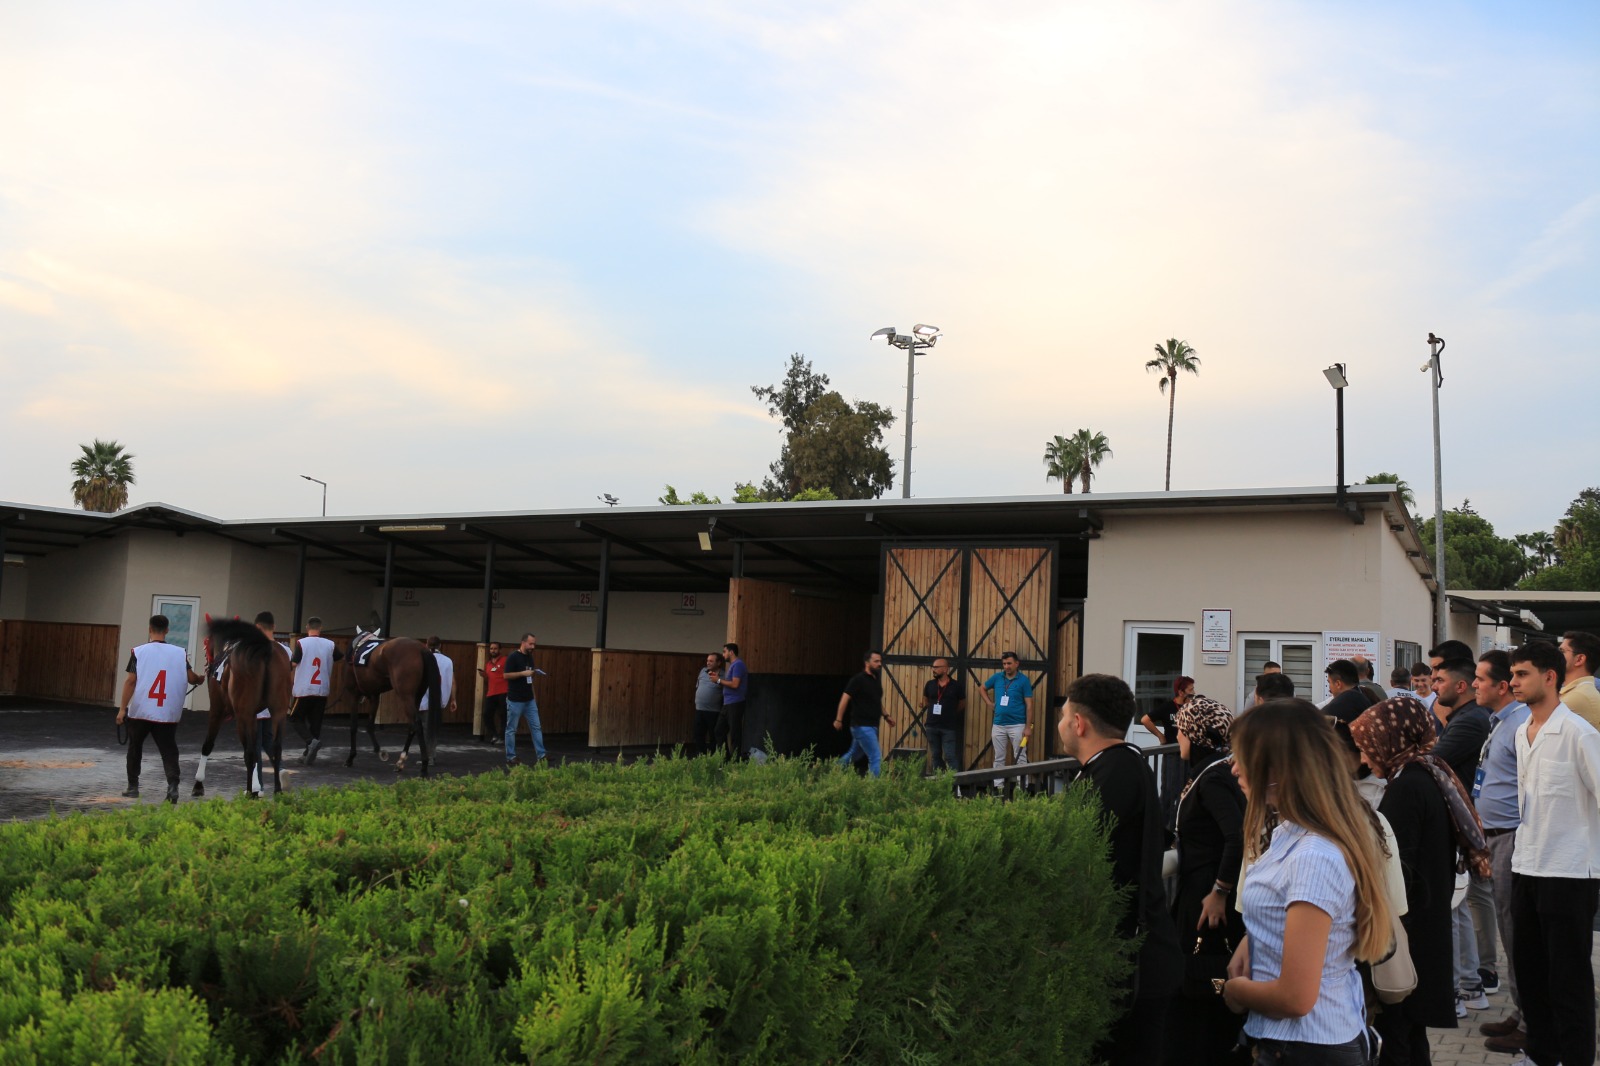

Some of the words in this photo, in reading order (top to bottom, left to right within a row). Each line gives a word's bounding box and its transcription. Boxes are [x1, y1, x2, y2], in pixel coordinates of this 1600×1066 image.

[580, 593, 590, 604] 25
[684, 595, 694, 606] 26
[358, 641, 380, 665] 2
[310, 657, 322, 685] 2
[148, 669, 167, 707] 4
